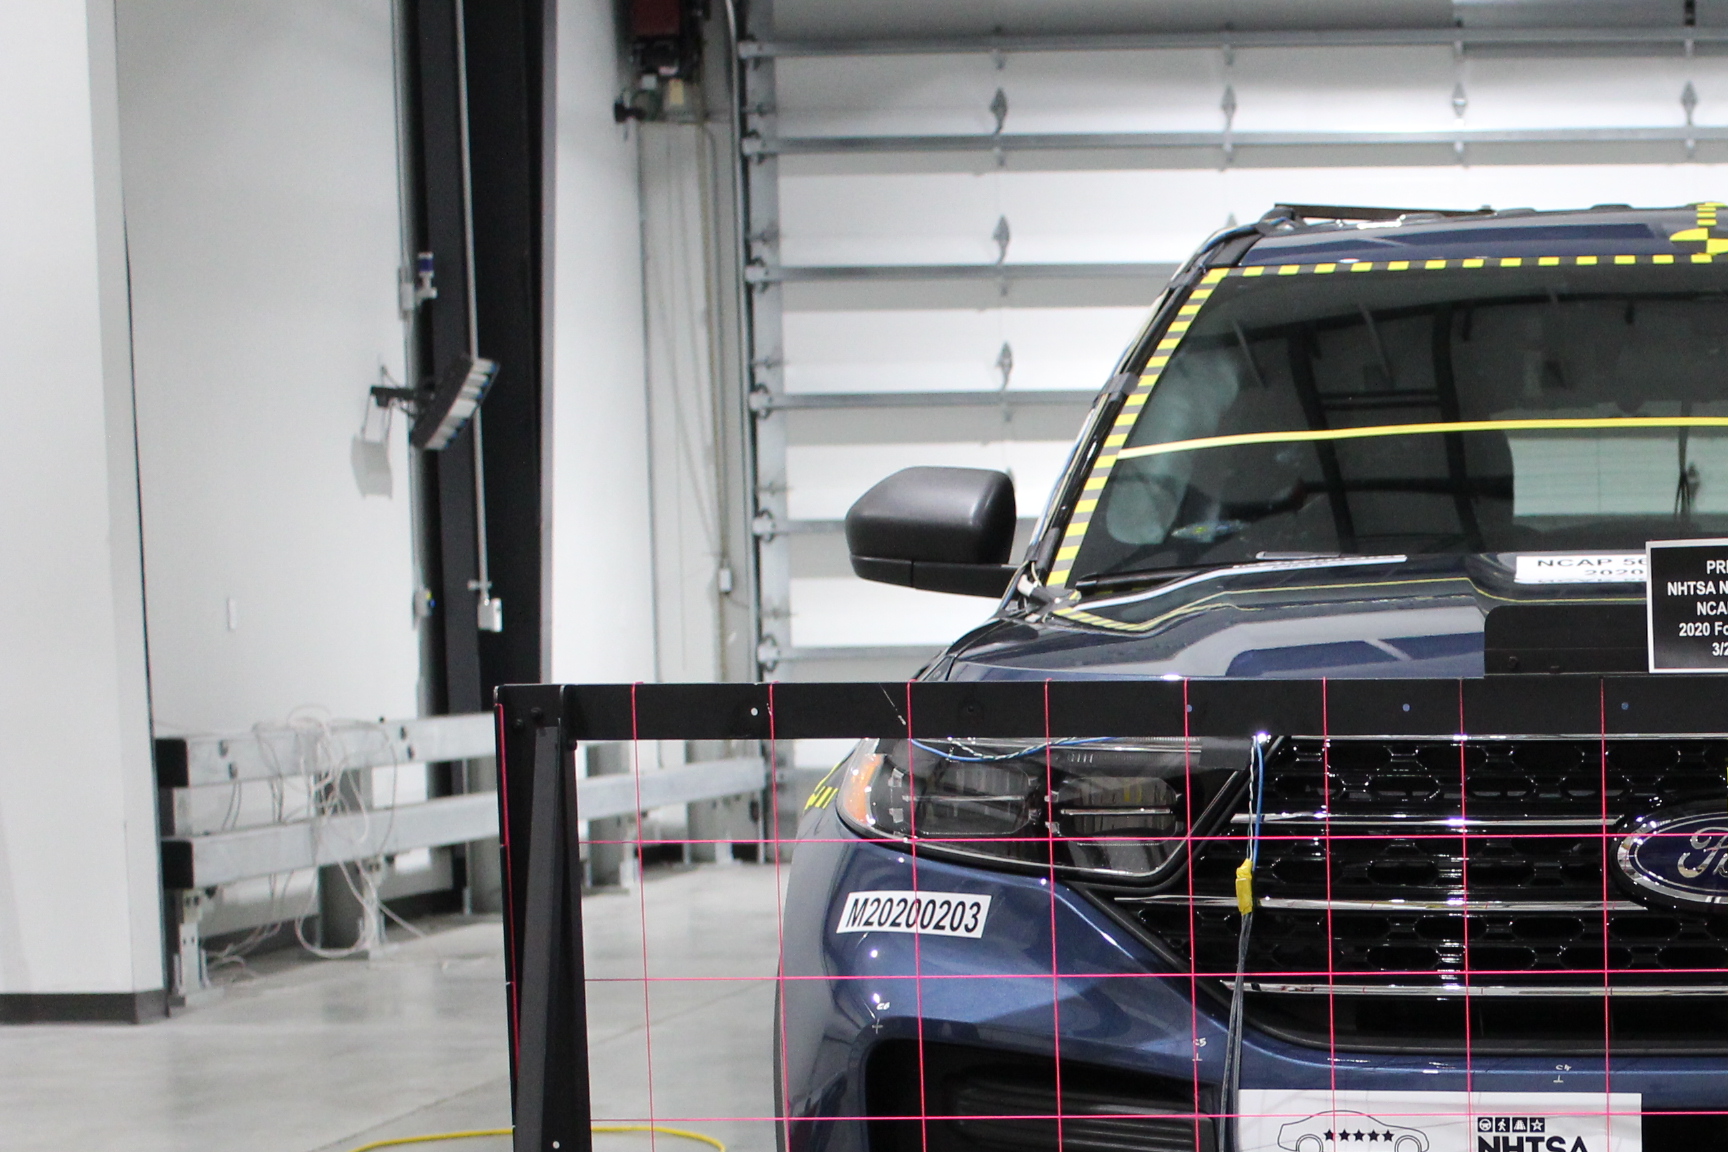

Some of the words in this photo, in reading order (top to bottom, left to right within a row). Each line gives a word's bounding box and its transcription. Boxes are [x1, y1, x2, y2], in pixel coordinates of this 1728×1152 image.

[1537, 559, 1612, 567] NCAP
[1667, 581, 1716, 596] NHTSA
[1679, 622, 1711, 637] 2020
[845, 897, 981, 933] M20200203
